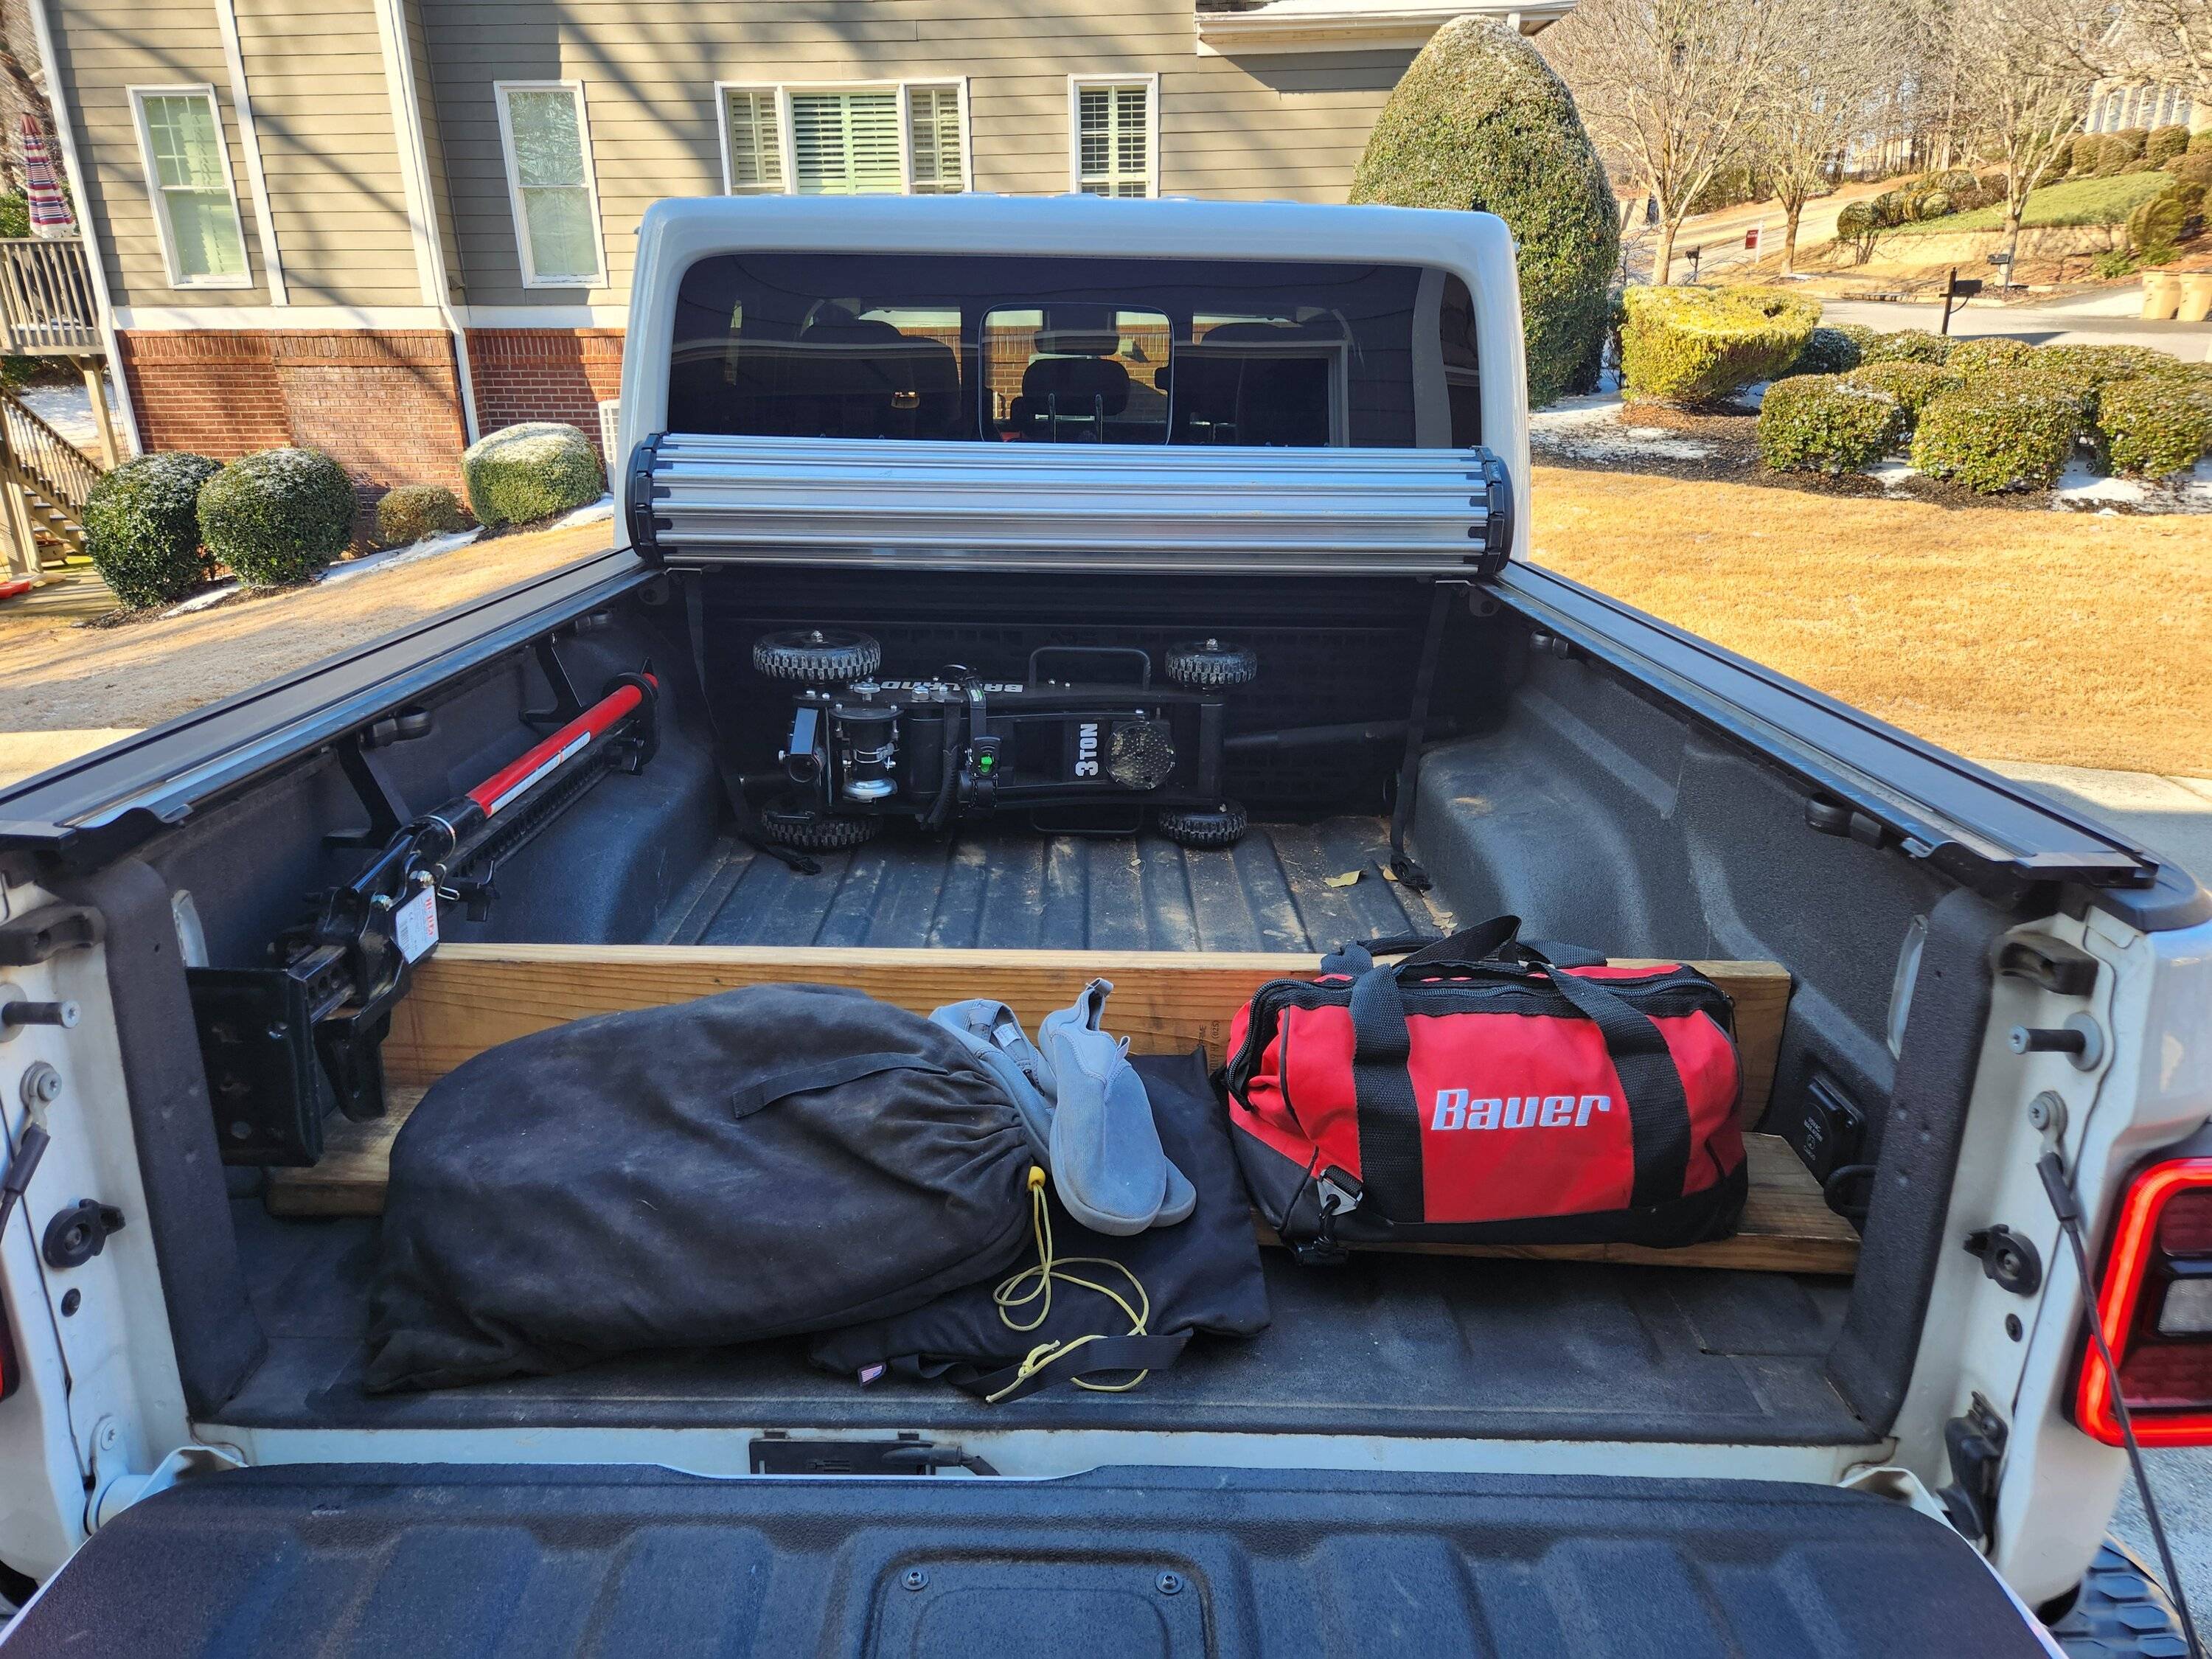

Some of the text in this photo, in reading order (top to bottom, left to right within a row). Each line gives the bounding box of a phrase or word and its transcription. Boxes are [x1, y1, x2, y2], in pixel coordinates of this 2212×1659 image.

[881, 681, 1023, 693] BALAND
[1076, 723, 1099, 776] 3 TON
[1430, 1088, 1610, 1130] Bauer
